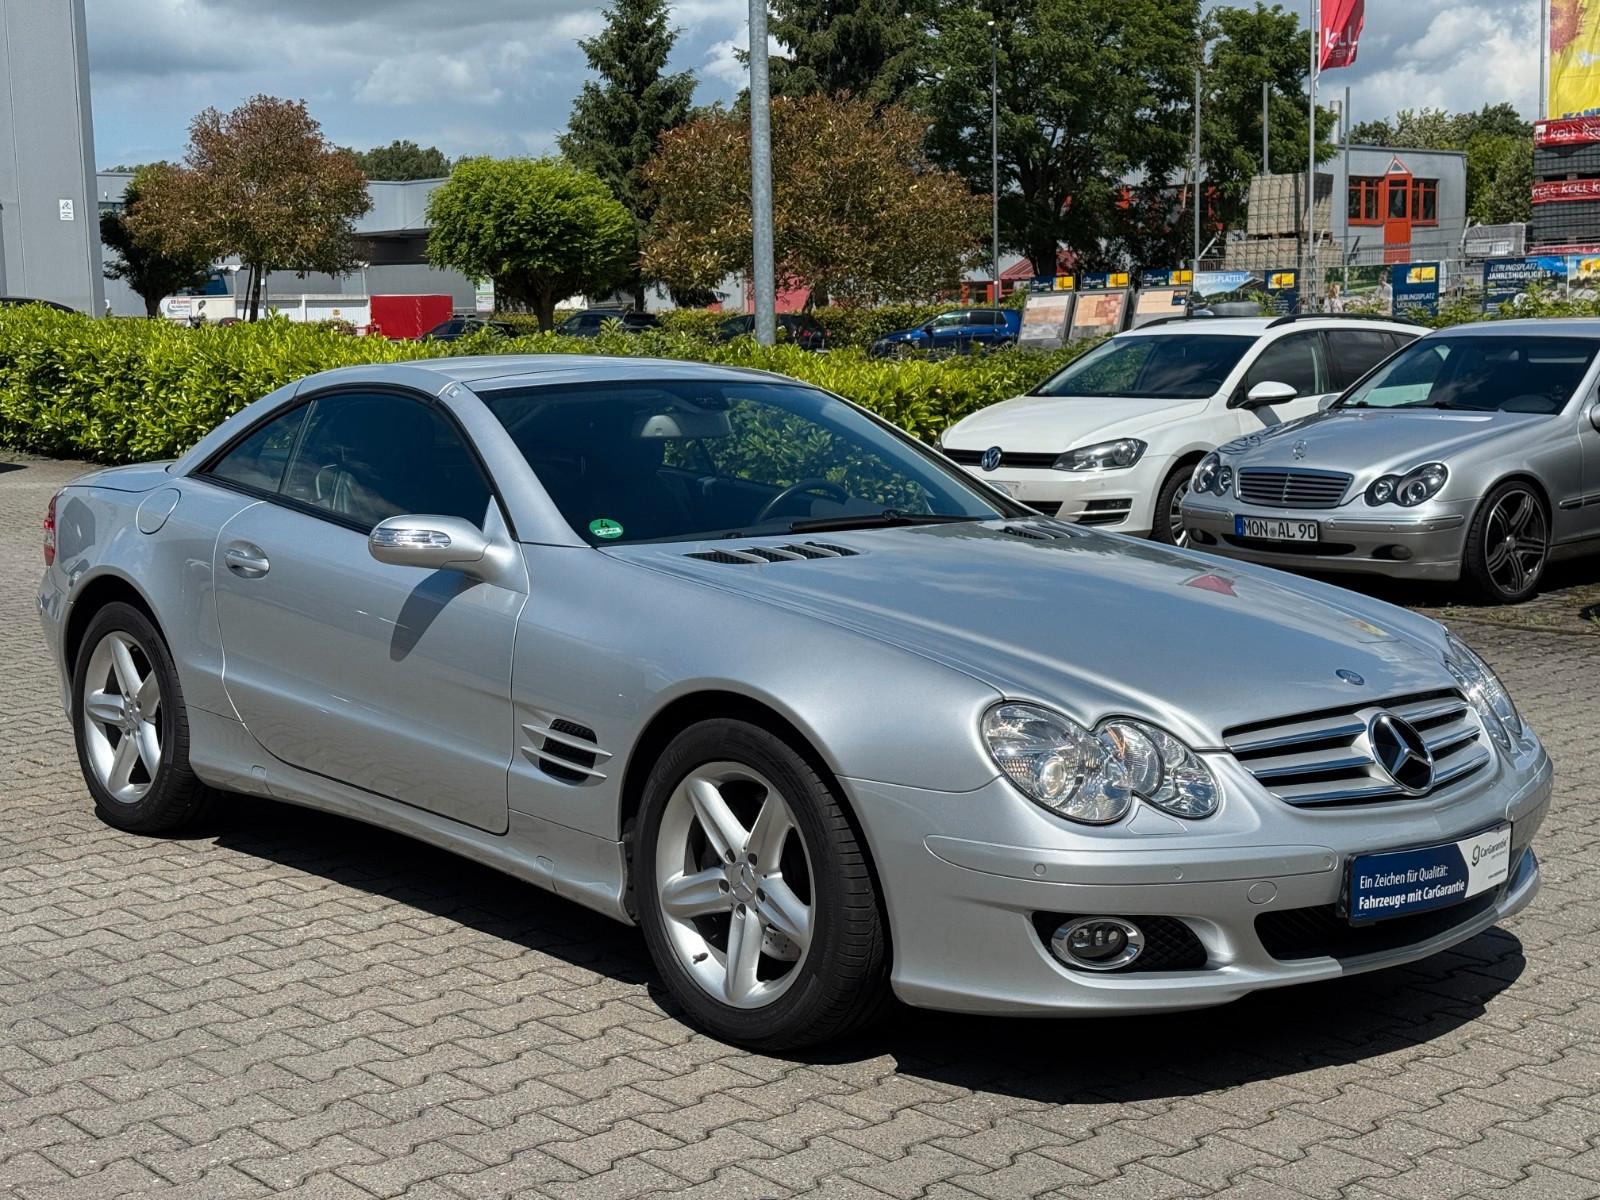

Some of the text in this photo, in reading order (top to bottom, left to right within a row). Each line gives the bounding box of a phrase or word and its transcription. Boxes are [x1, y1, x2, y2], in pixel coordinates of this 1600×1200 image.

[1244, 519, 1317, 539] MON AL 90
[1360, 865, 1449, 889] Ein Zeichen für Qualität:
[1359, 880, 1465, 910] Fahrzeuge mit CarGarantie
